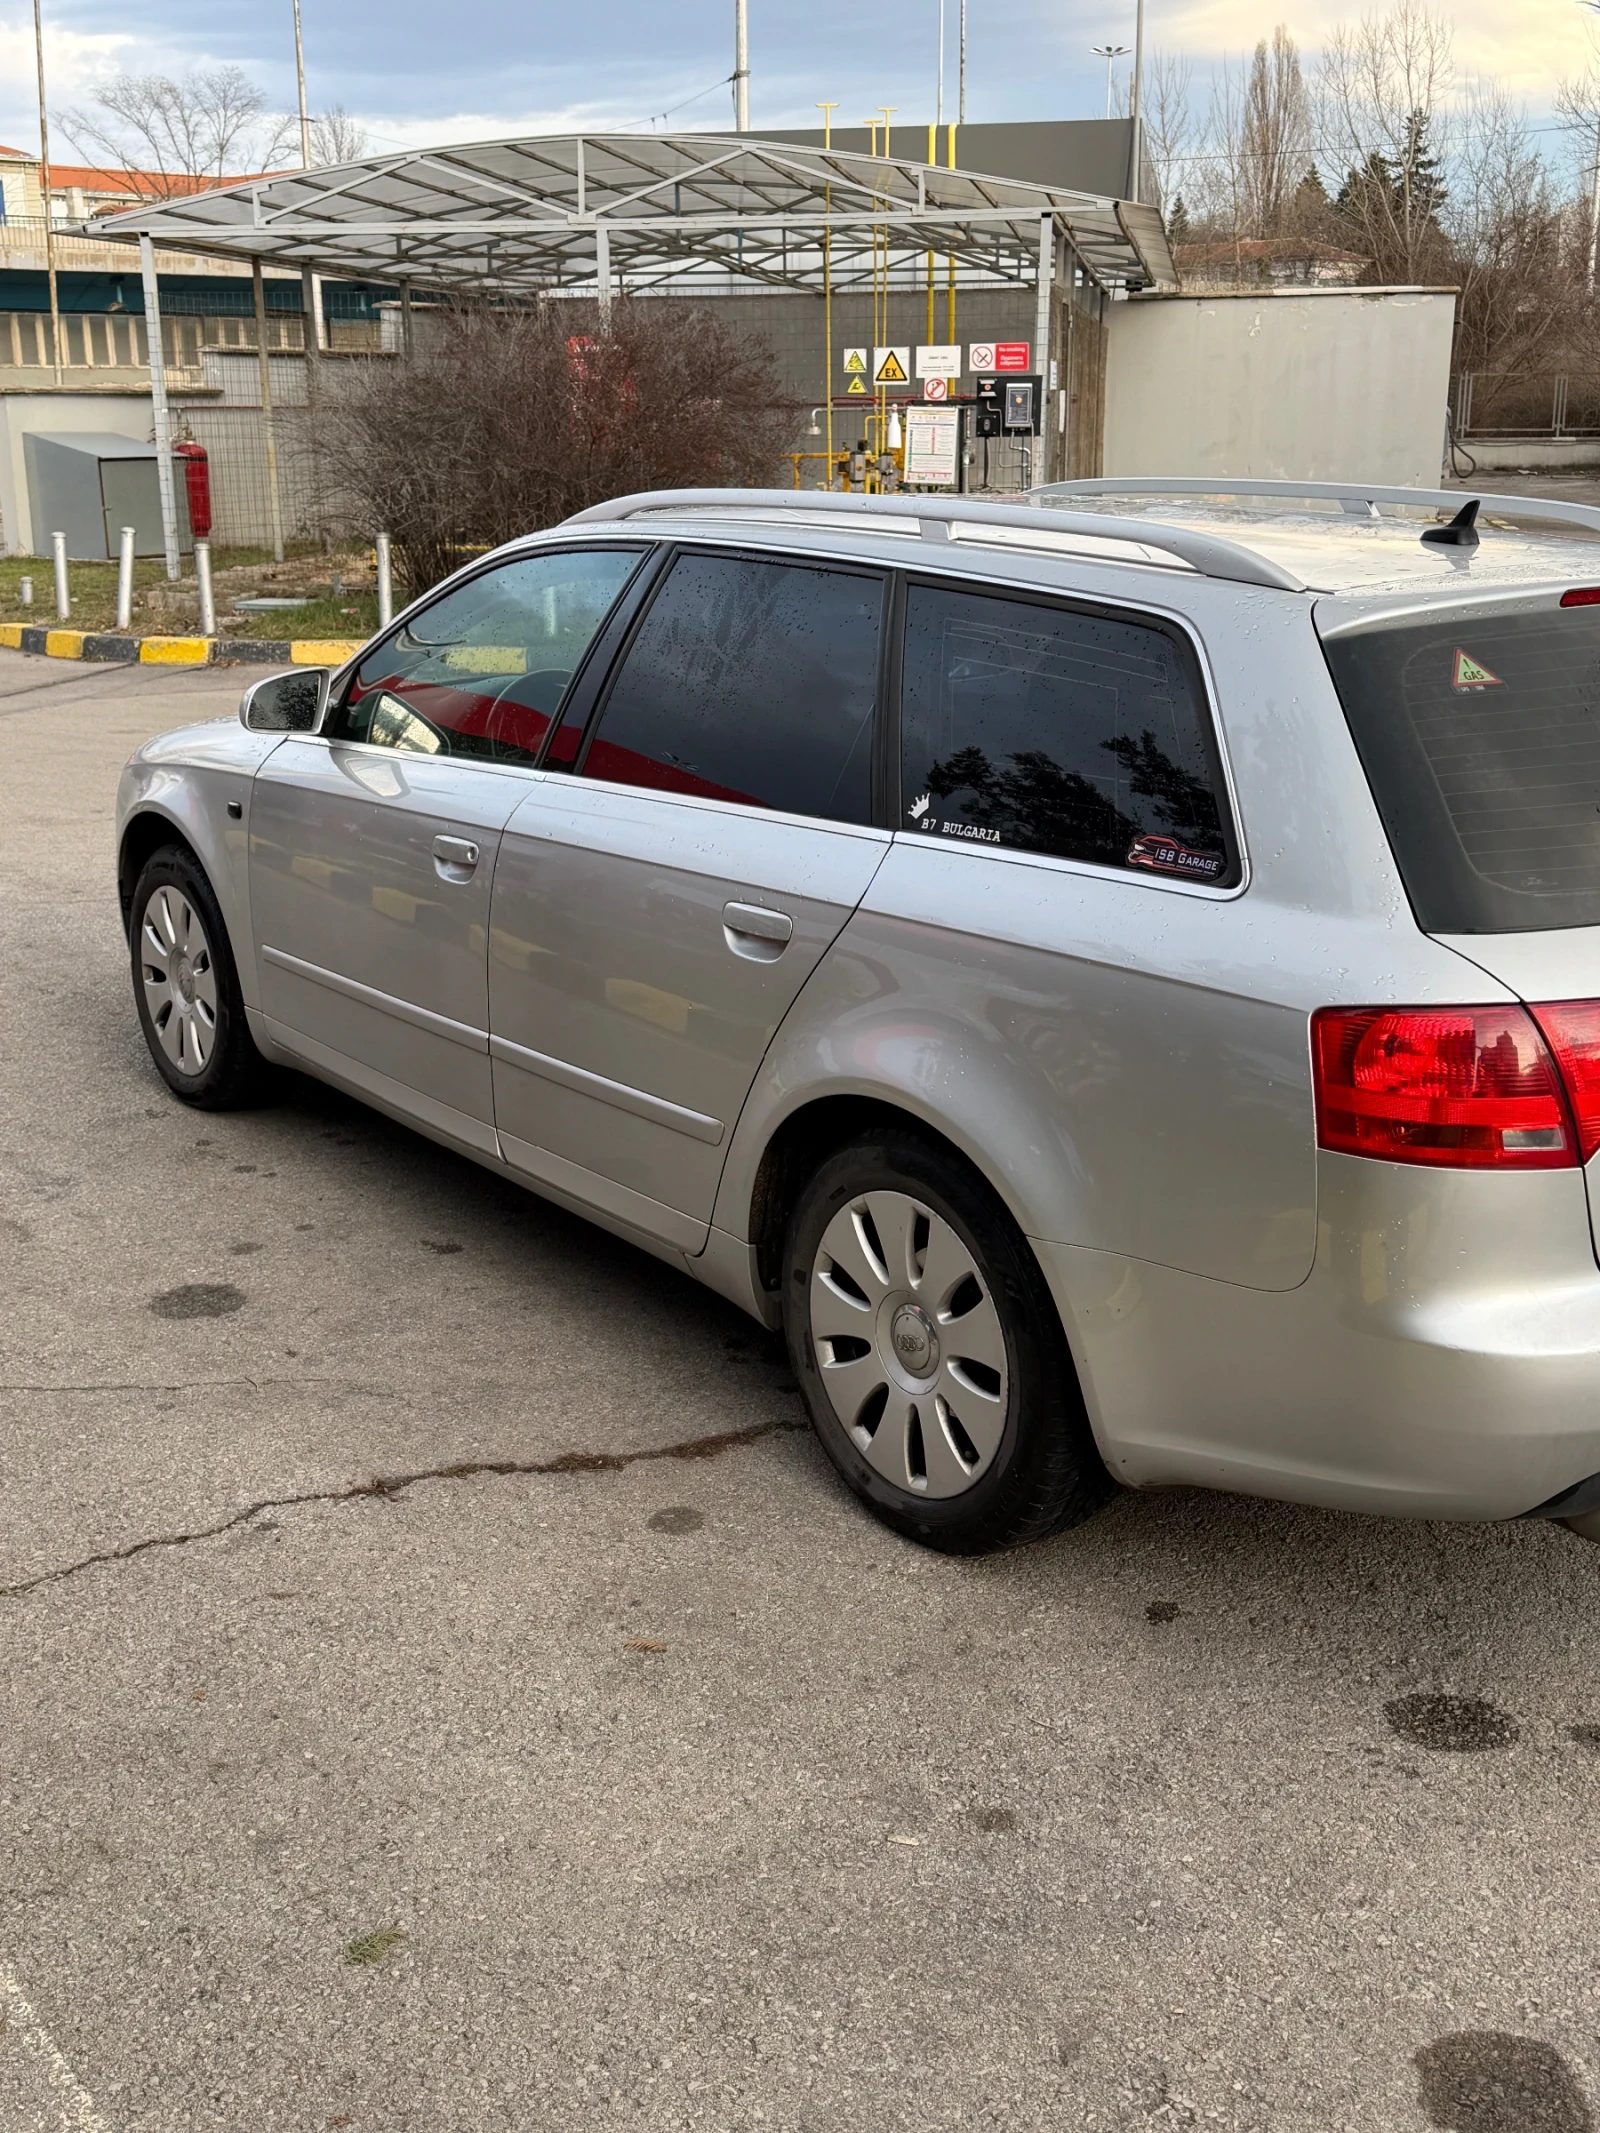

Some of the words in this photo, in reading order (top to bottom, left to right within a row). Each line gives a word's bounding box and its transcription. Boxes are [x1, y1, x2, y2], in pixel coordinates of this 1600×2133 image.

[885, 368, 897, 377] EX
[1463, 670, 1485, 681] GAS
[921, 818, 937, 830] B7
[942, 821, 1001, 842] BULGARIA
[1178, 853, 1219, 871] GARAGE
